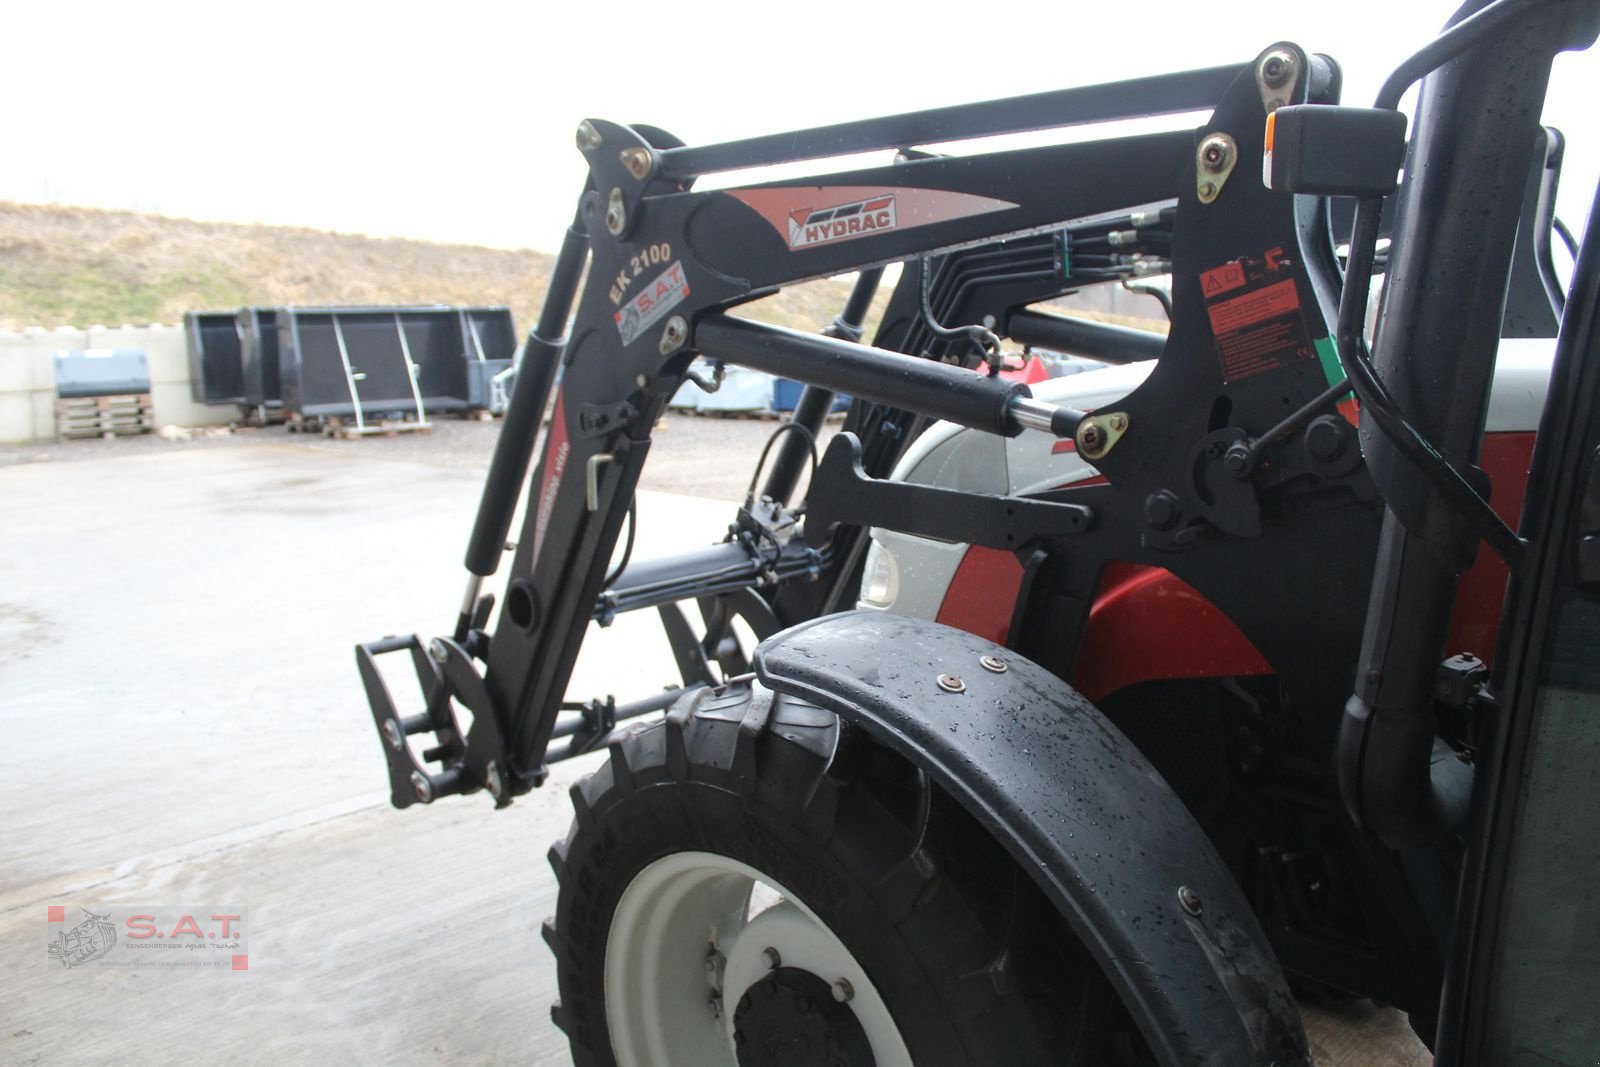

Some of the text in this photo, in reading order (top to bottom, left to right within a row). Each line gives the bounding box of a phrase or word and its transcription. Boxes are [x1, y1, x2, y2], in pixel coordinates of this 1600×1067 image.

[805, 211, 890, 242] HYDRAC
[609, 242, 671, 305] EK 2100
